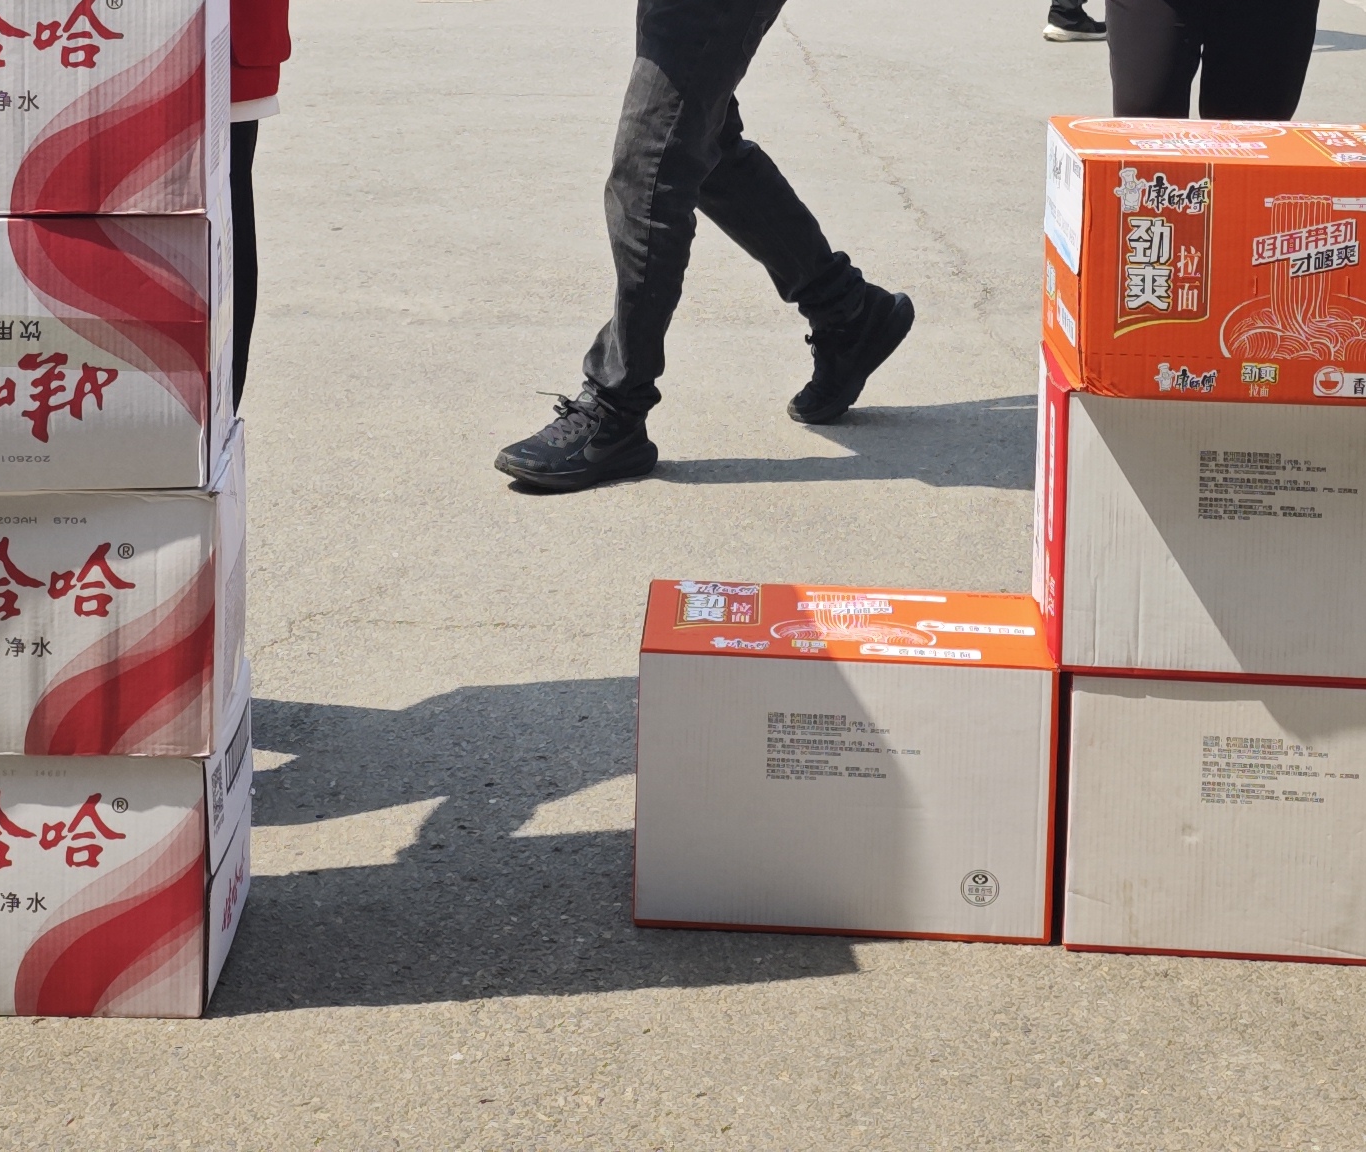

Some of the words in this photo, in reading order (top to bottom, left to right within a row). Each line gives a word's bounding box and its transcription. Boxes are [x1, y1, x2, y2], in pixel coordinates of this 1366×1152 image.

[1146, 175, 1210, 214] 康師傅
[1253, 219, 1357, 264] 好面带劲
[1291, 245, 1359, 276] 才够爽
[1125, 217, 1173, 311] 劲爽
[1177, 245, 1202, 313] 拉面
[1242, 364, 1279, 384] 劲爽
[1249, 384, 1270, 398] 拉面
